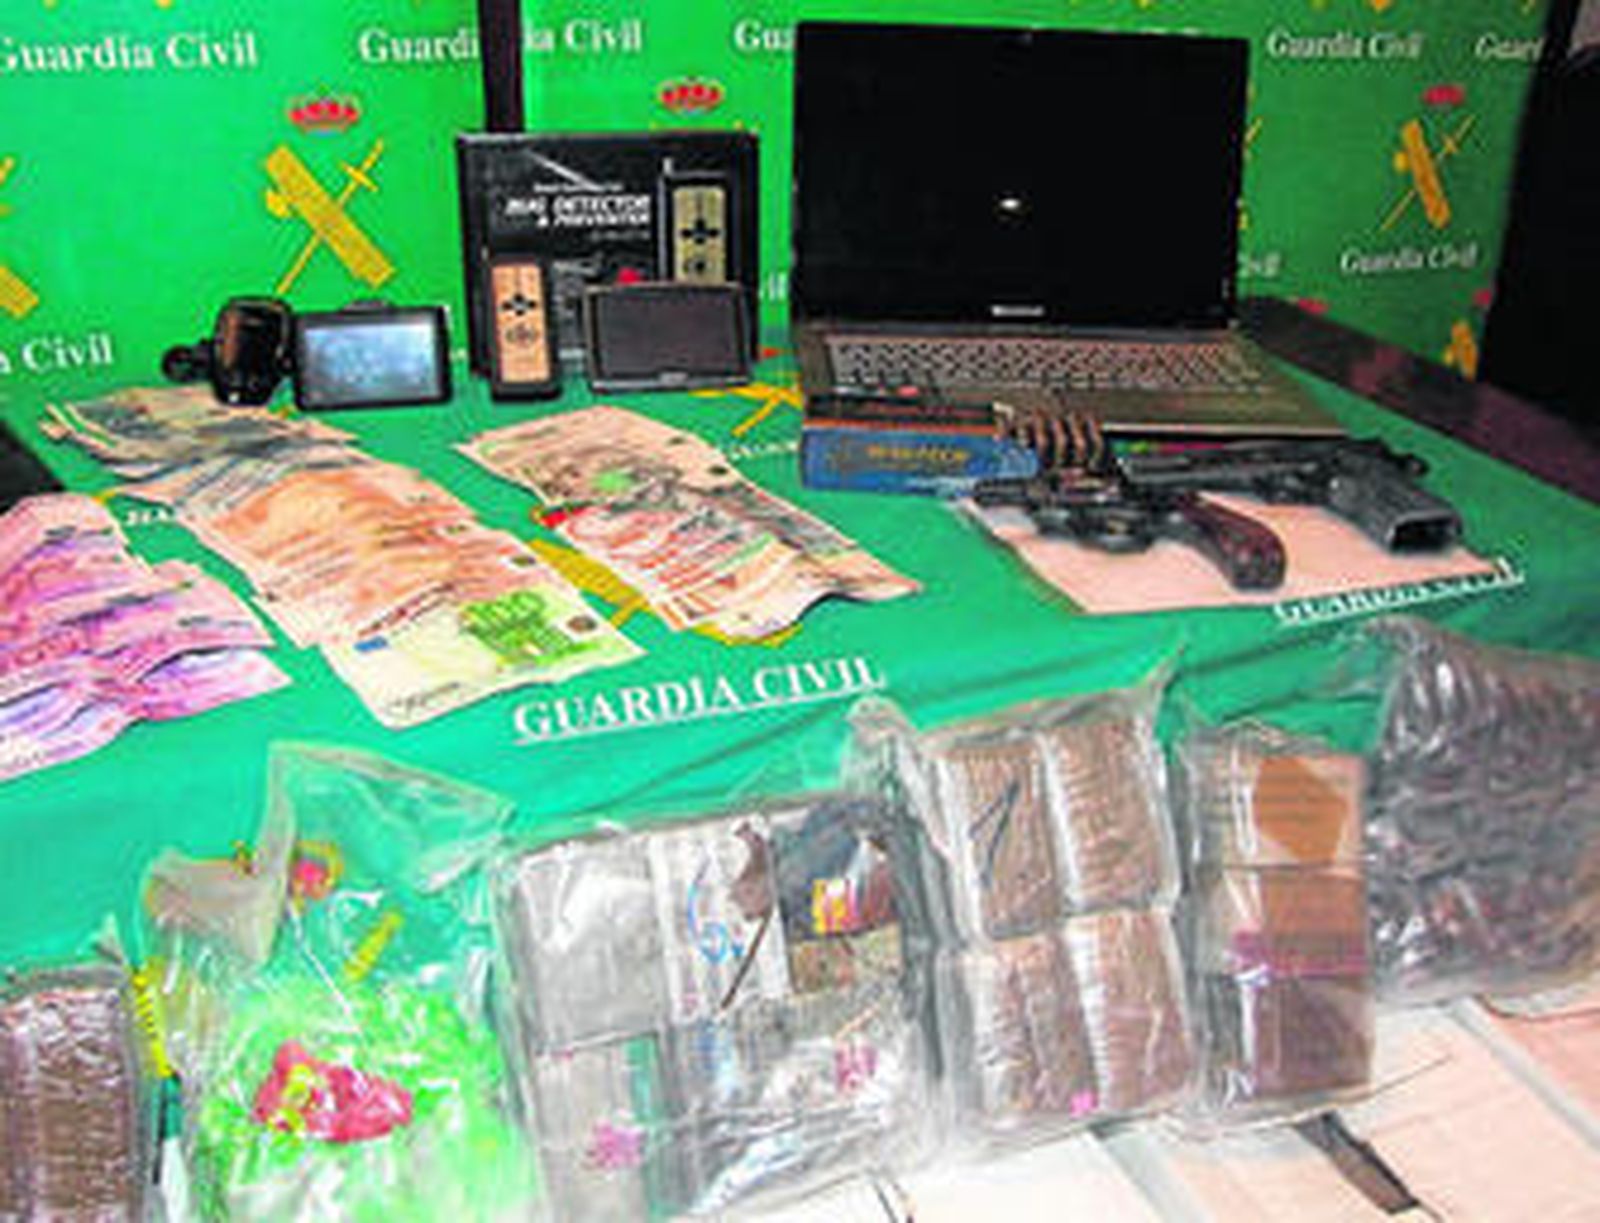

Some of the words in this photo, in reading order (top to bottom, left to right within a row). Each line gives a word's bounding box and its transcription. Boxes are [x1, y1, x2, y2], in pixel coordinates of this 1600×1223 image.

[166, 31, 259, 67] Civil
[359, 27, 479, 62] Guardi
[565, 18, 643, 50] Civil
[1266, 26, 1363, 59] Guardia
[1341, 247, 1423, 274] Guardia
[22, 332, 114, 374] Civil
[513, 675, 742, 740] GUARDIA
[753, 656, 886, 702] CIVIL
